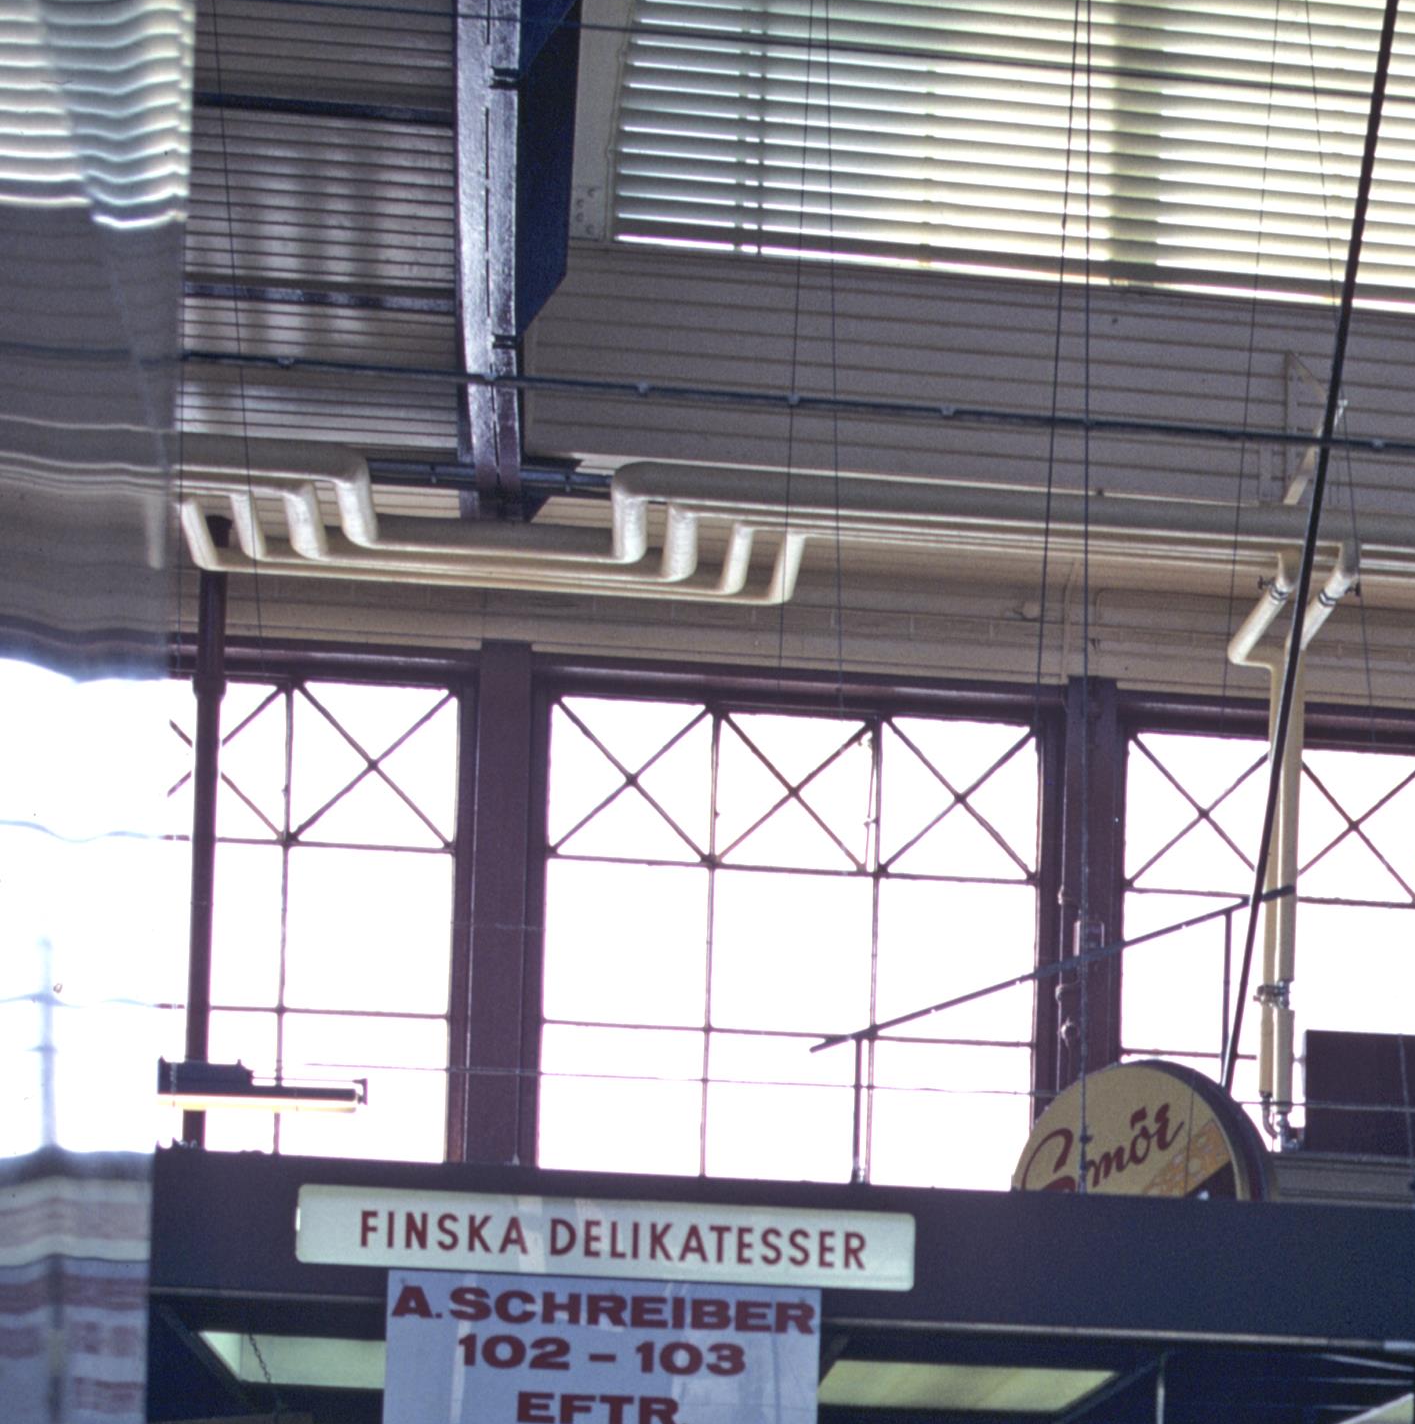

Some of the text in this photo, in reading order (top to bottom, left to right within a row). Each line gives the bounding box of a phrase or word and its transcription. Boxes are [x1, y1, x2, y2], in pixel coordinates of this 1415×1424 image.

[360, 1210, 868, 1270] FINSKA DELIKATESSER
[459, 1333, 571, 1371] 102
[635, 1342, 747, 1377] 103
